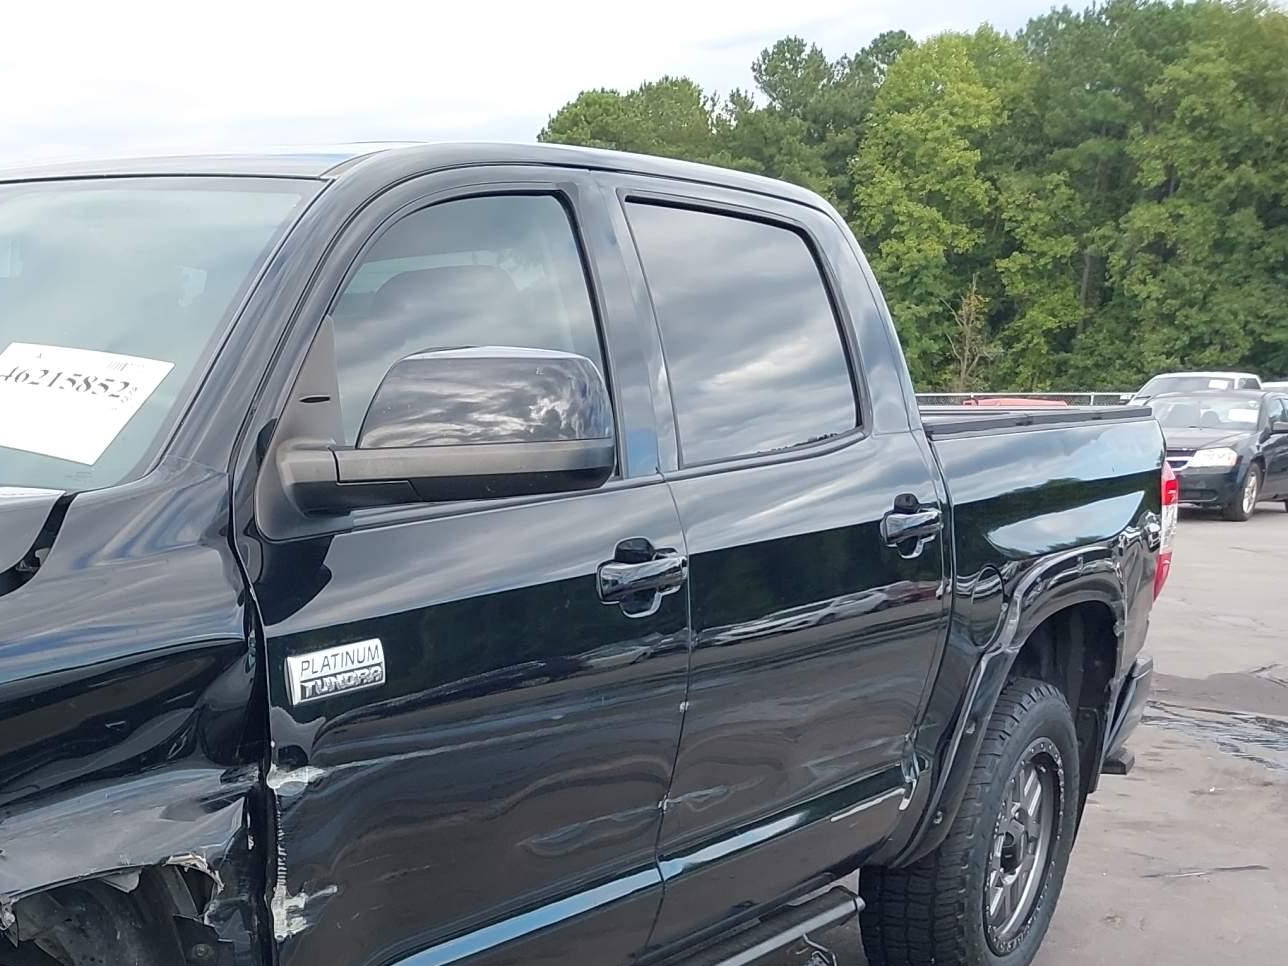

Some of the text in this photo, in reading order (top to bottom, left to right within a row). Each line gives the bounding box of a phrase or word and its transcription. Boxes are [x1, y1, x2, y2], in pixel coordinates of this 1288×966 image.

[0, 366, 131, 398] 46215852
[300, 644, 379, 678] PLATINUM
[301, 666, 383, 698] TUNDRA
